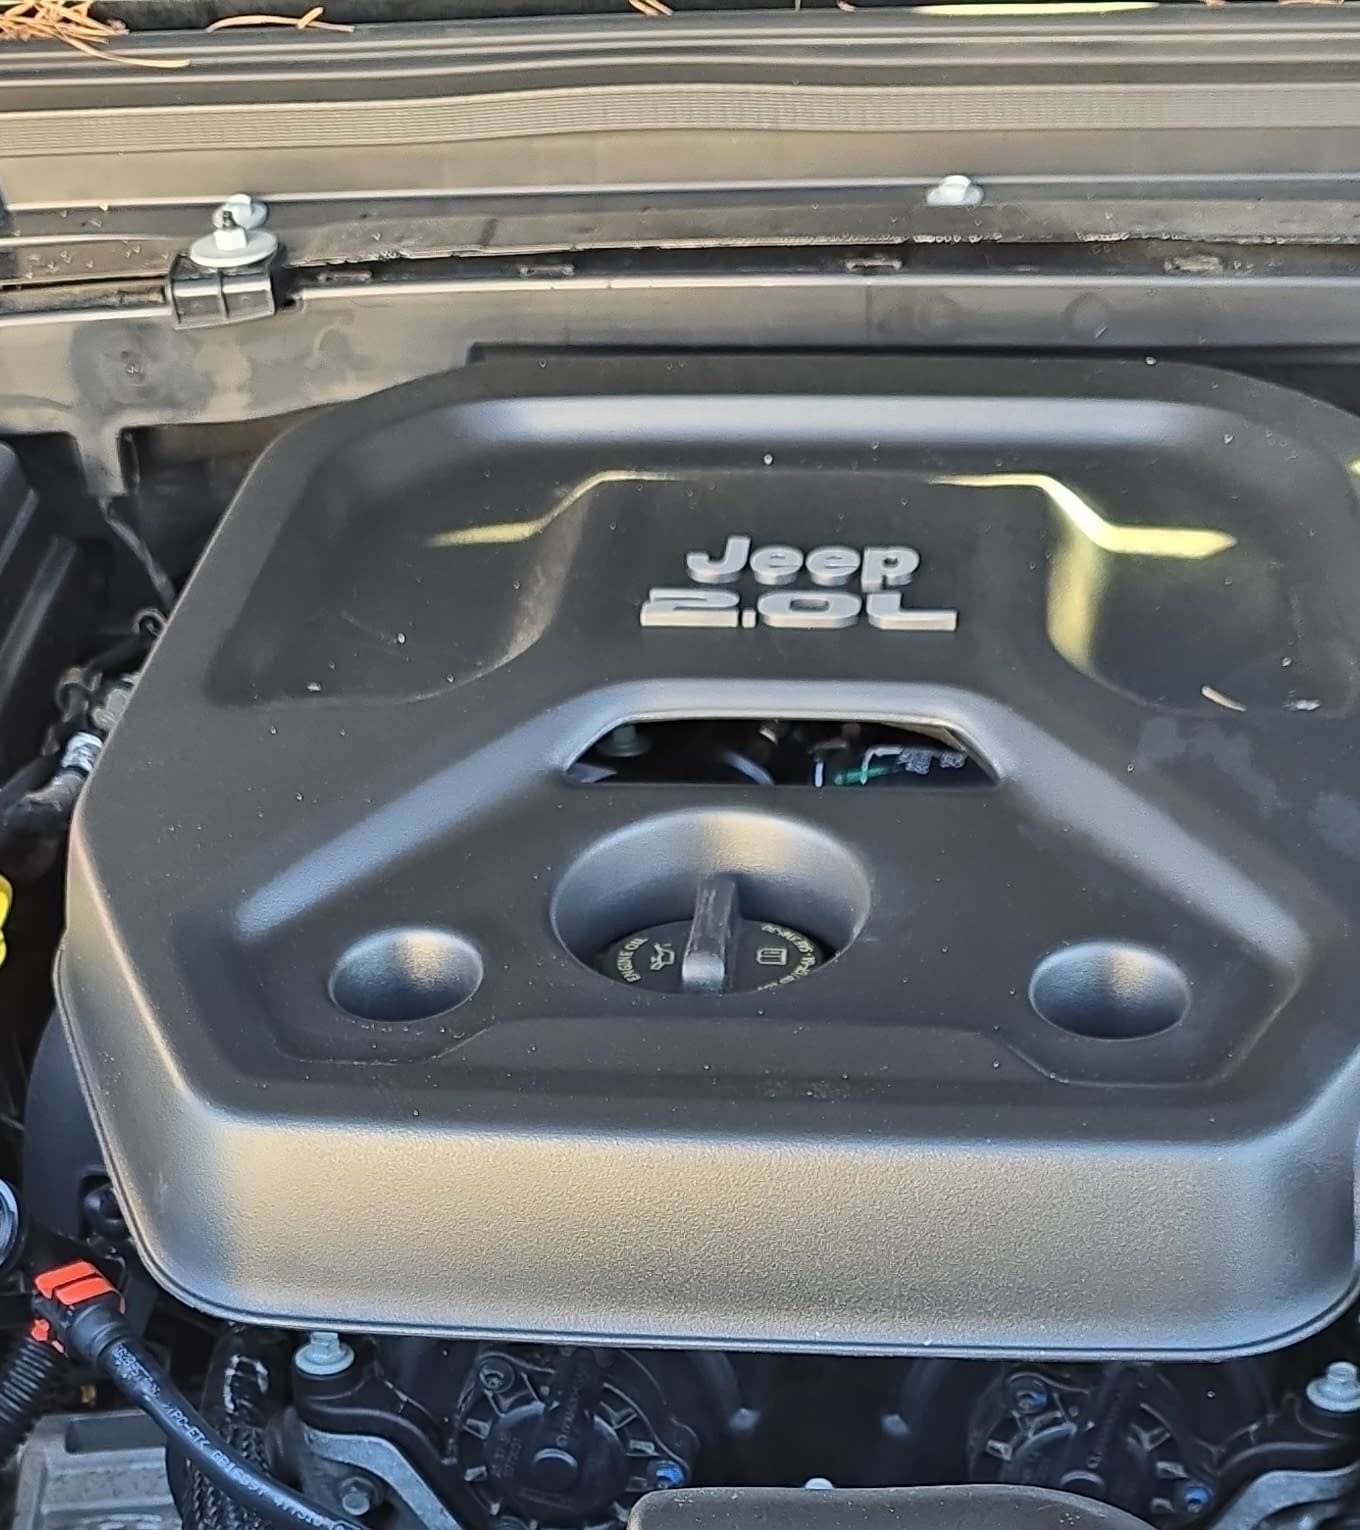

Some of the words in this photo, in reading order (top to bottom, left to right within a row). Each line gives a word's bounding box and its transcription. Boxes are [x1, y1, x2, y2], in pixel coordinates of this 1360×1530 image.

[686, 535, 921, 593] Jeep
[640, 587, 958, 631] 2.0L
[616, 949, 641, 983] ENGINE
